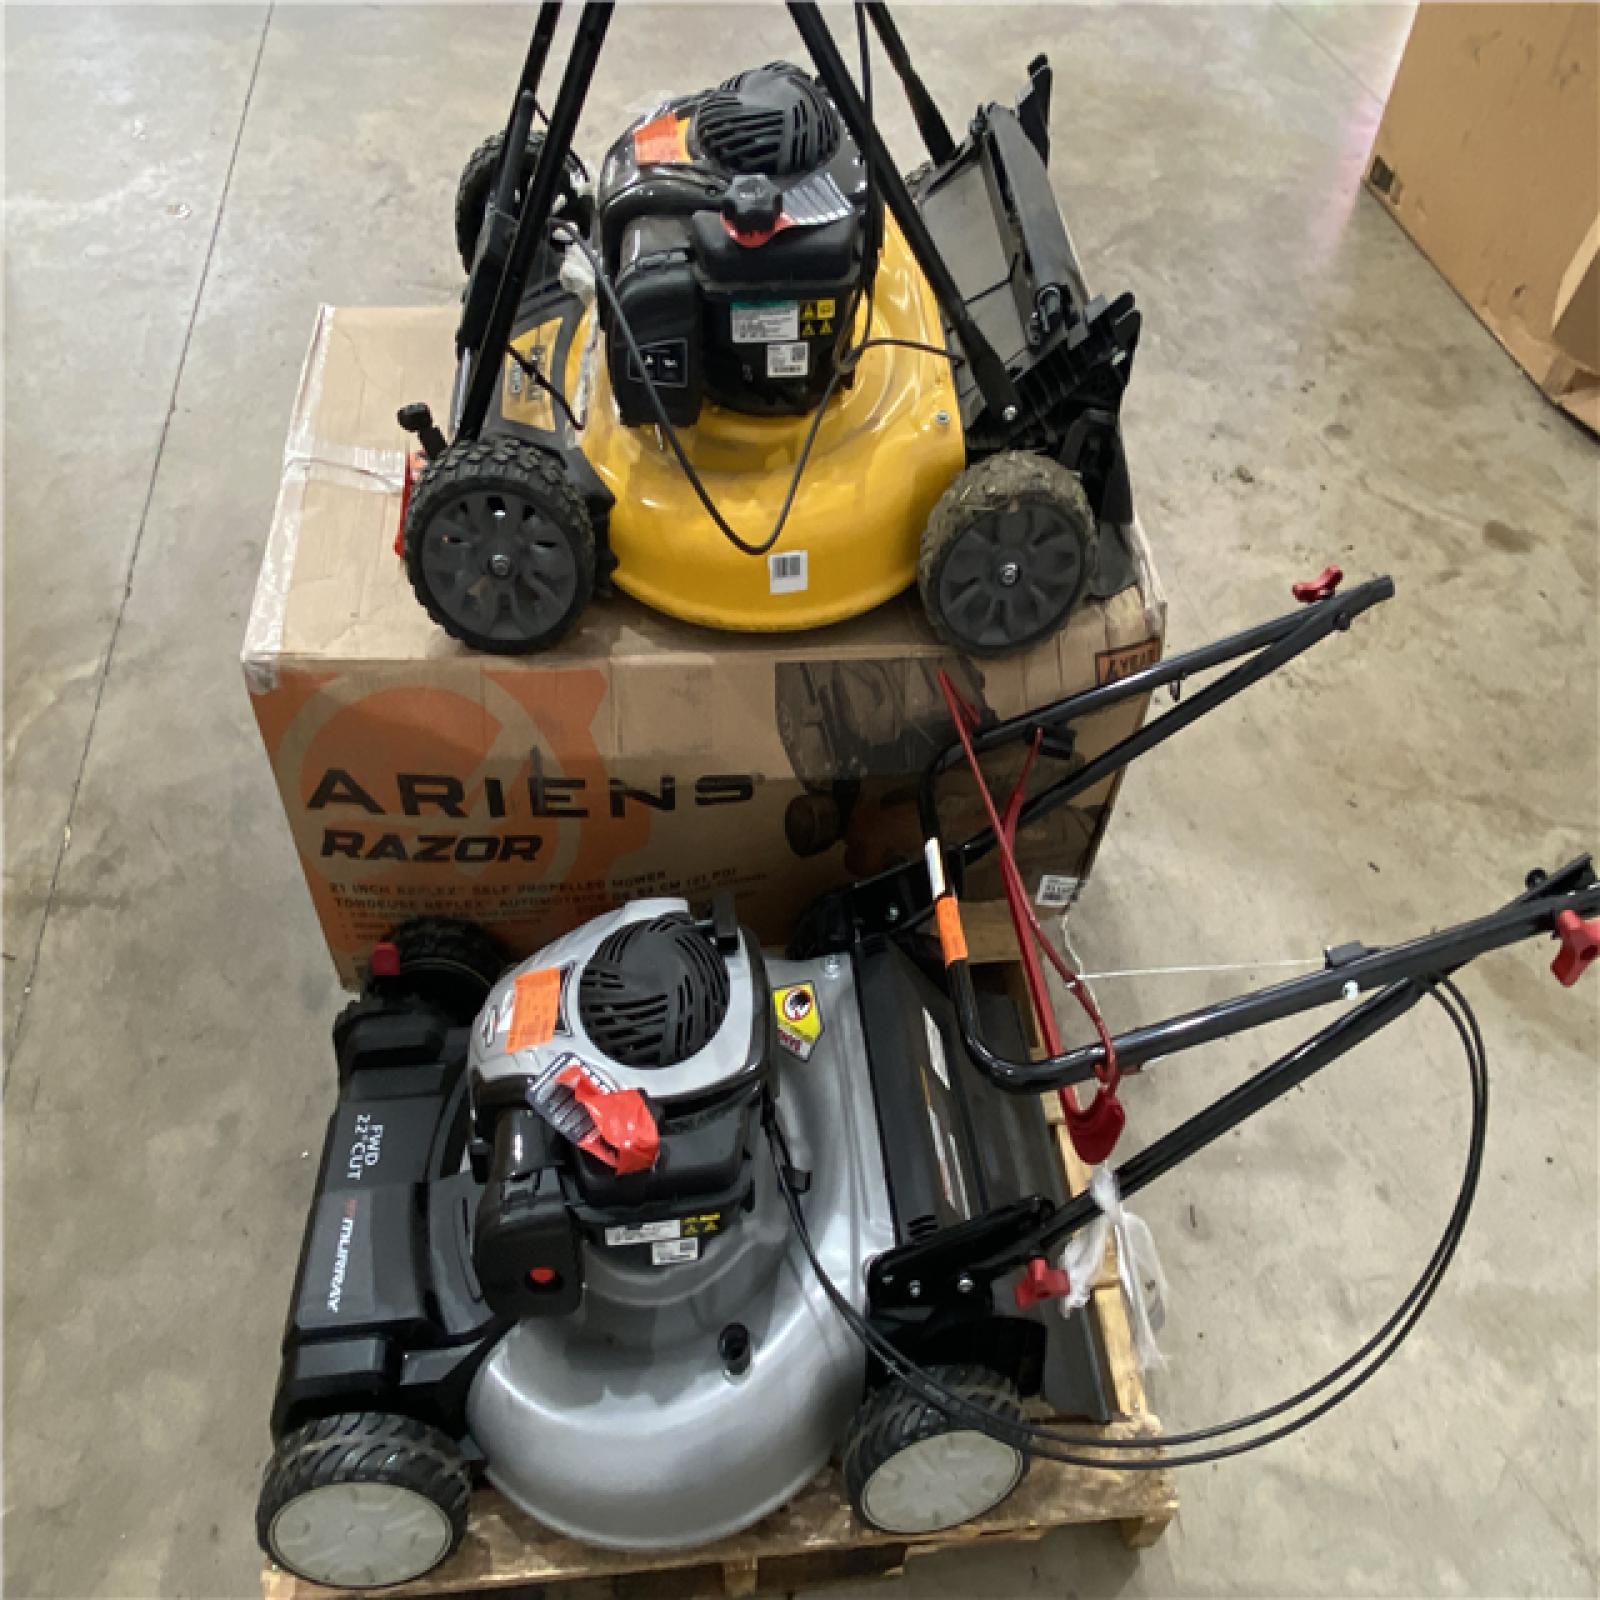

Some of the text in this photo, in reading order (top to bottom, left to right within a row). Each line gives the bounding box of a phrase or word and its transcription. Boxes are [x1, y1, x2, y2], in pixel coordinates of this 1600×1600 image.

[306, 769, 754, 818] ARIENS
[320, 828, 545, 864] RAZOR
[352, 883, 391, 895] INCH
[472, 884, 508, 896] SELF
[517, 880, 606, 894] PROPELLED
[612, 872, 666, 888] MOWER
[659, 880, 682, 893] CM
[364, 1124, 385, 1166] FWD
[327, 1216, 354, 1314] MURRAY
